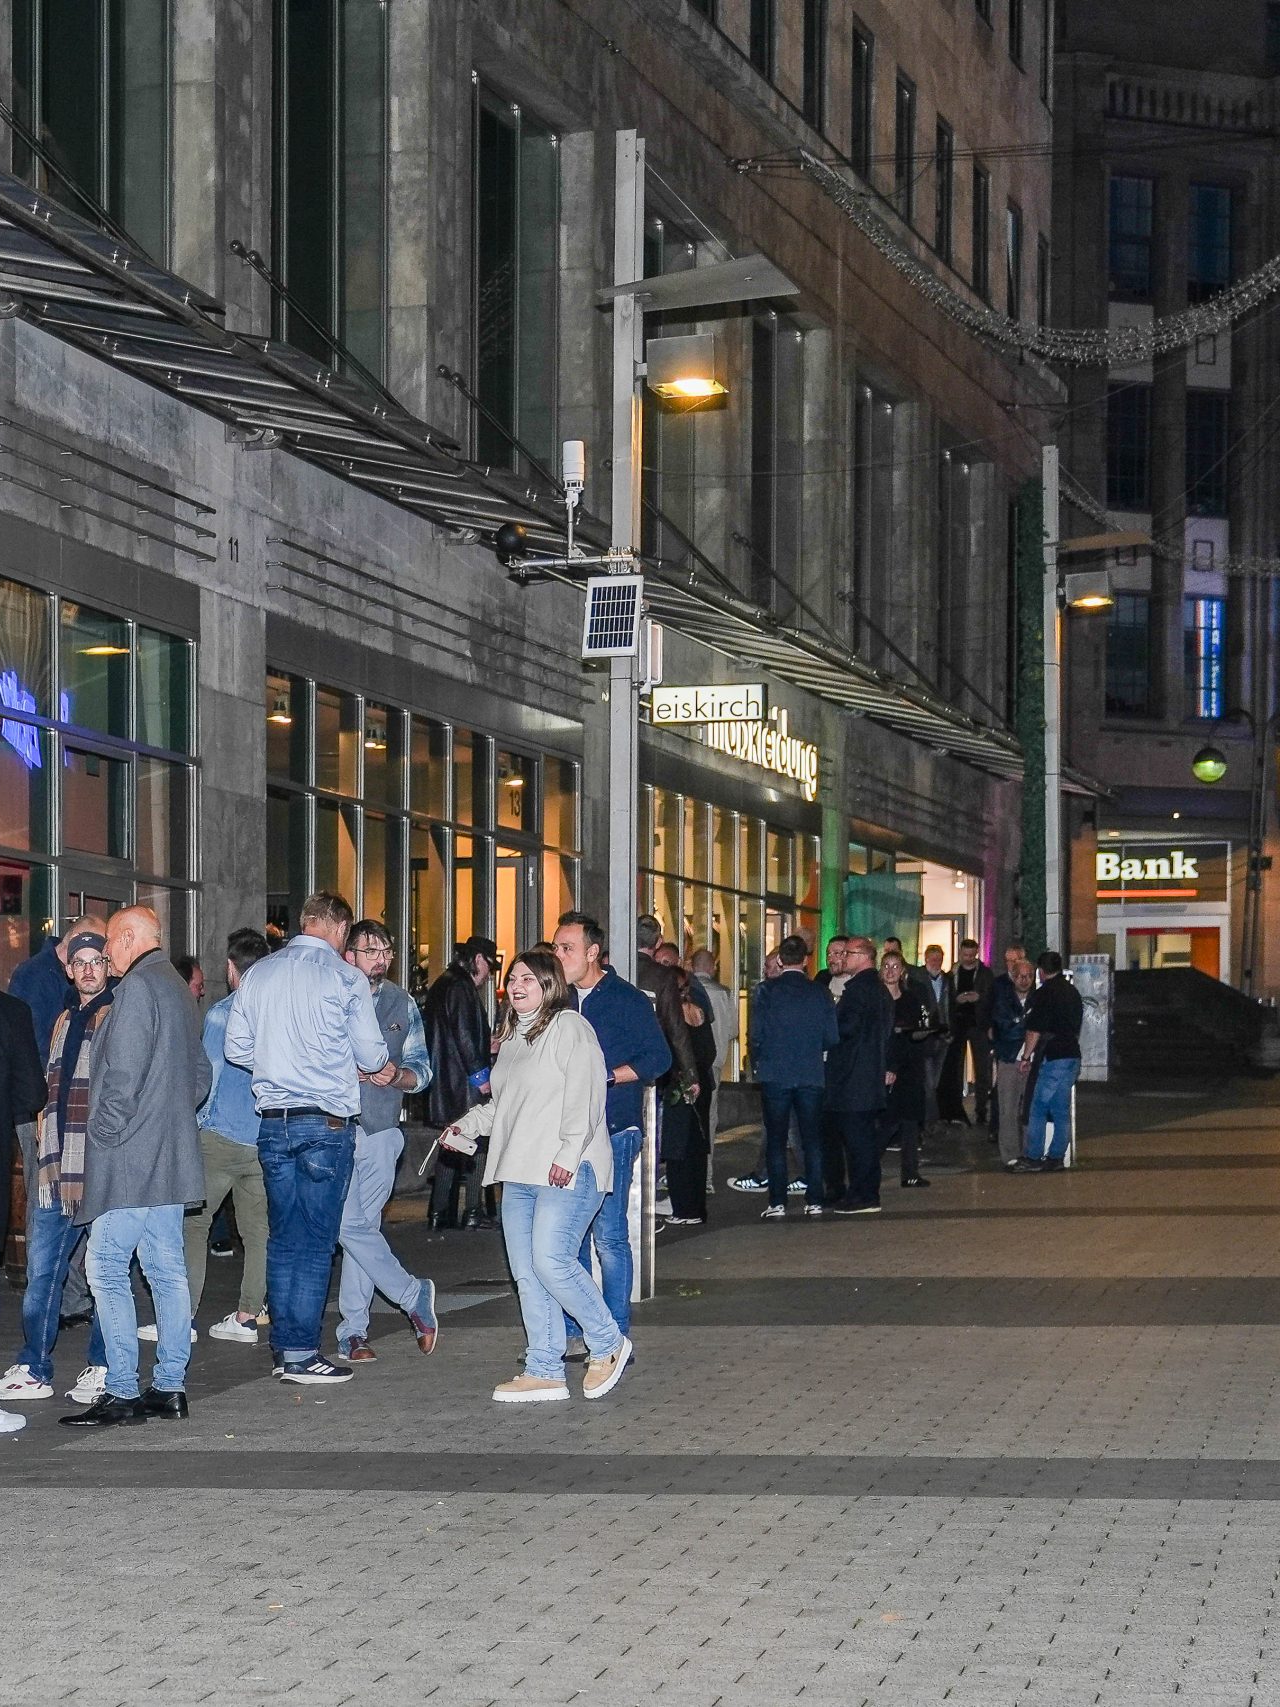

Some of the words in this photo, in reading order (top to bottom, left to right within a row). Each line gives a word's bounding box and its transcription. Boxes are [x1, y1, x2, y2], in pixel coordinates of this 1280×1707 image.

[228, 536, 239, 563] 11
[656, 688, 760, 721] eiskirch
[510, 790, 521, 817] 13
[1096, 851, 1198, 881] Bank
